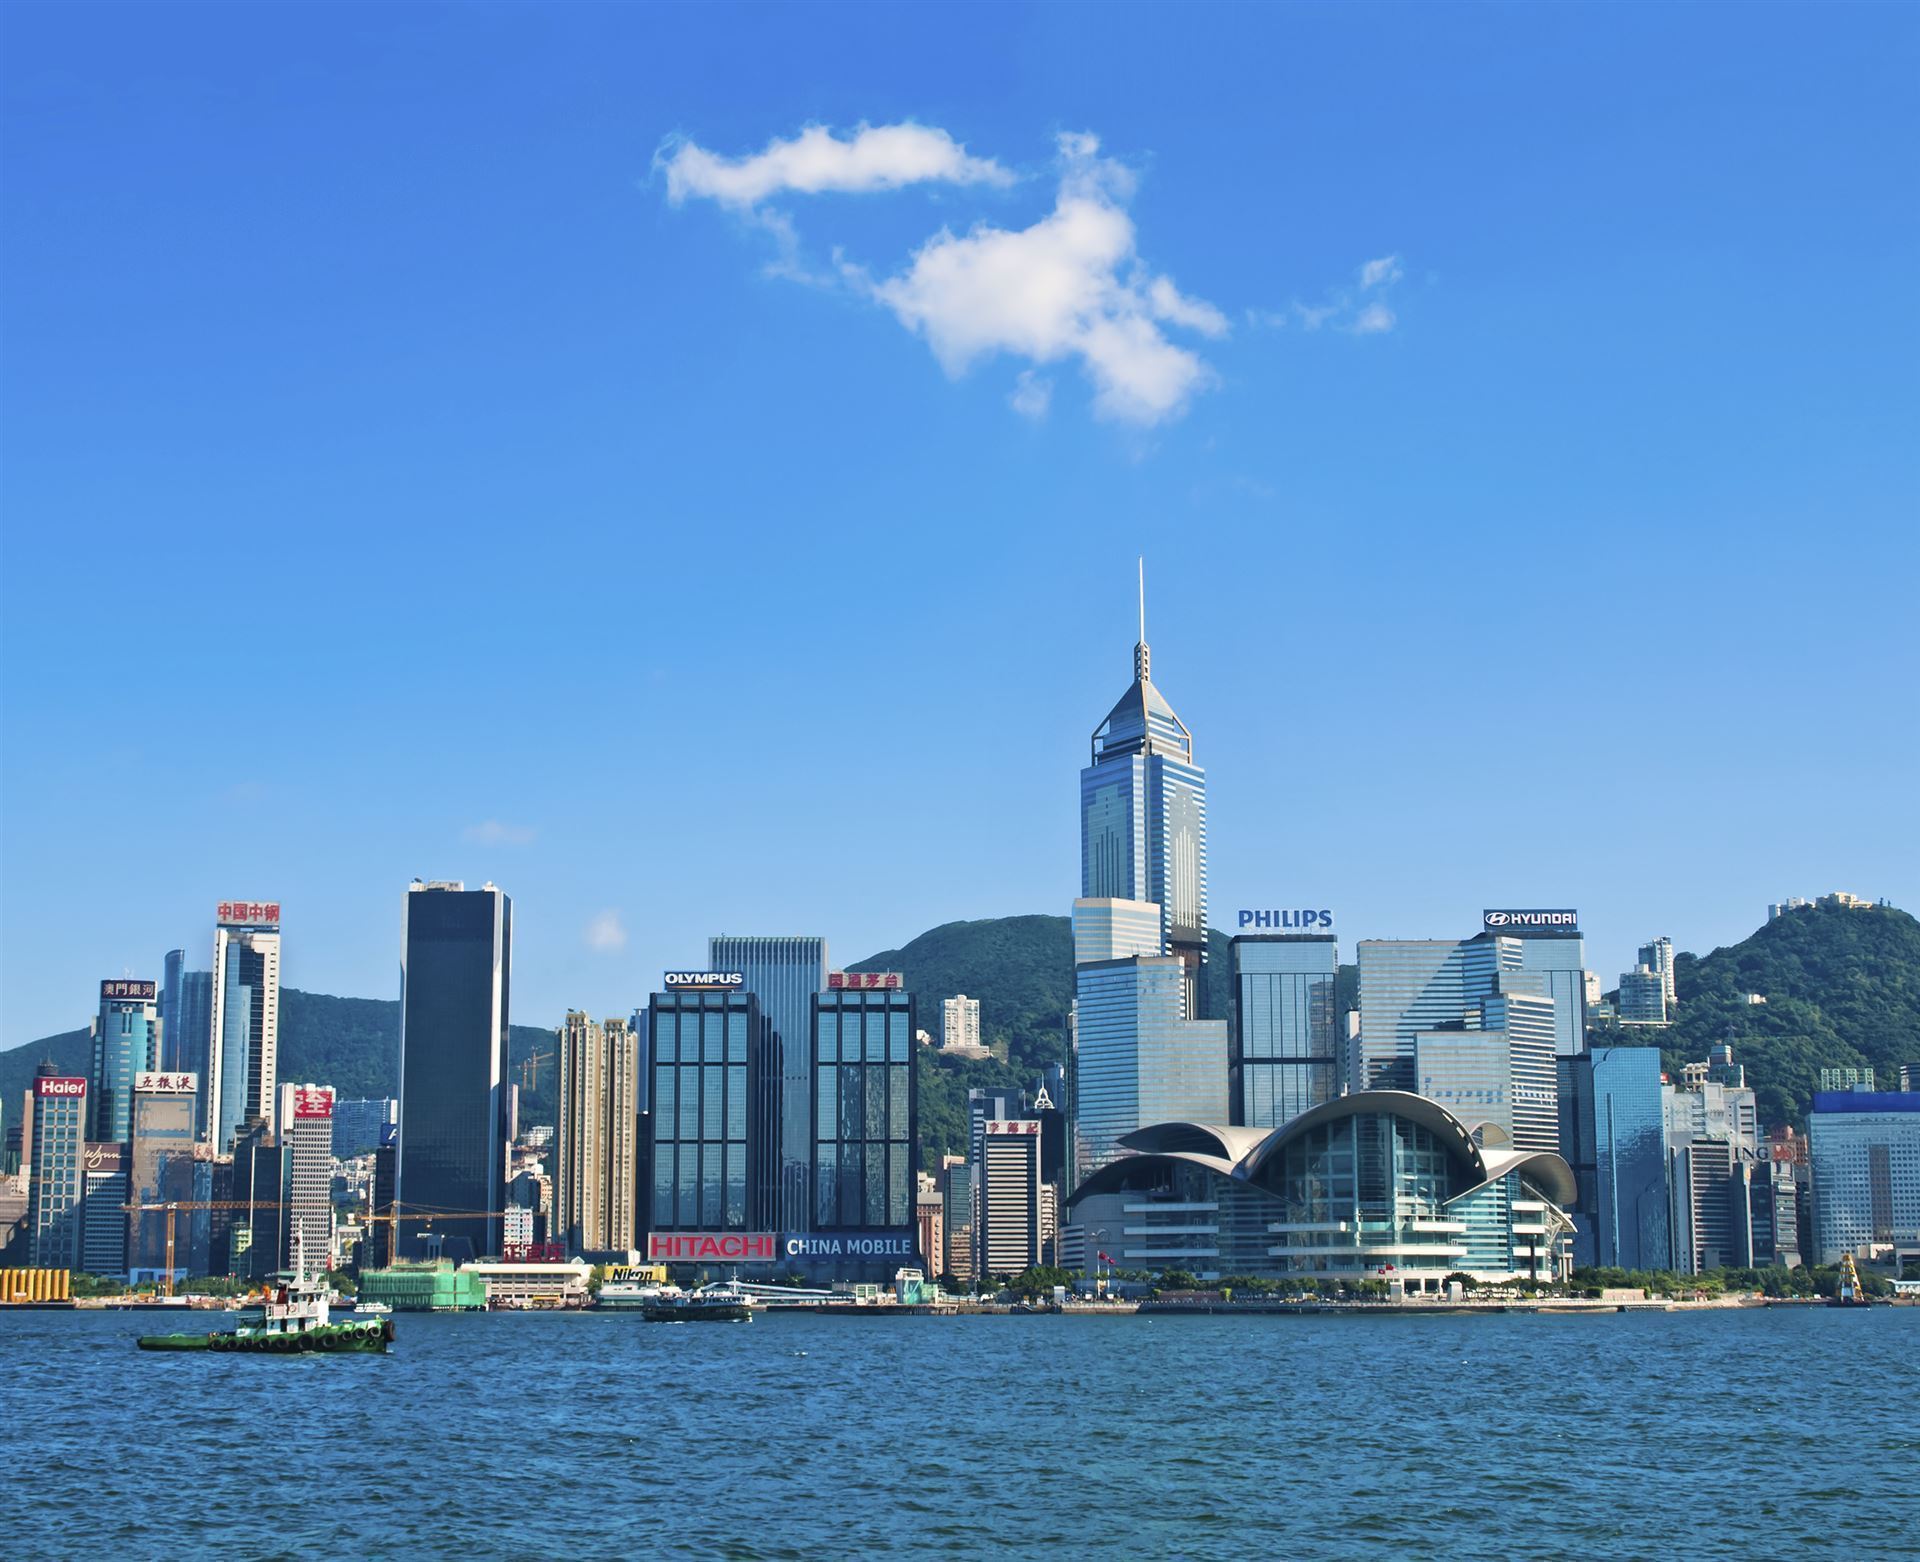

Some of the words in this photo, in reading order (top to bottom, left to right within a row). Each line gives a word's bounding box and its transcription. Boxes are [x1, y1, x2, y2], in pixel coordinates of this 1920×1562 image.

[1238, 909, 1332, 927] PHILIPS
[1511, 913, 1576, 925] HYUNDAI
[665, 973, 743, 984] OLYMPUS
[103, 983, 154, 997] 澳門銀河
[41, 1081, 85, 1094] Haier
[84, 1145, 122, 1168] Wynn
[1735, 1147, 1768, 1160] ING
[651, 1237, 773, 1257] HITACHI
[786, 1239, 842, 1255] CHINA
[846, 1239, 911, 1254] MOBILE
[612, 1268, 653, 1281] Nikon
